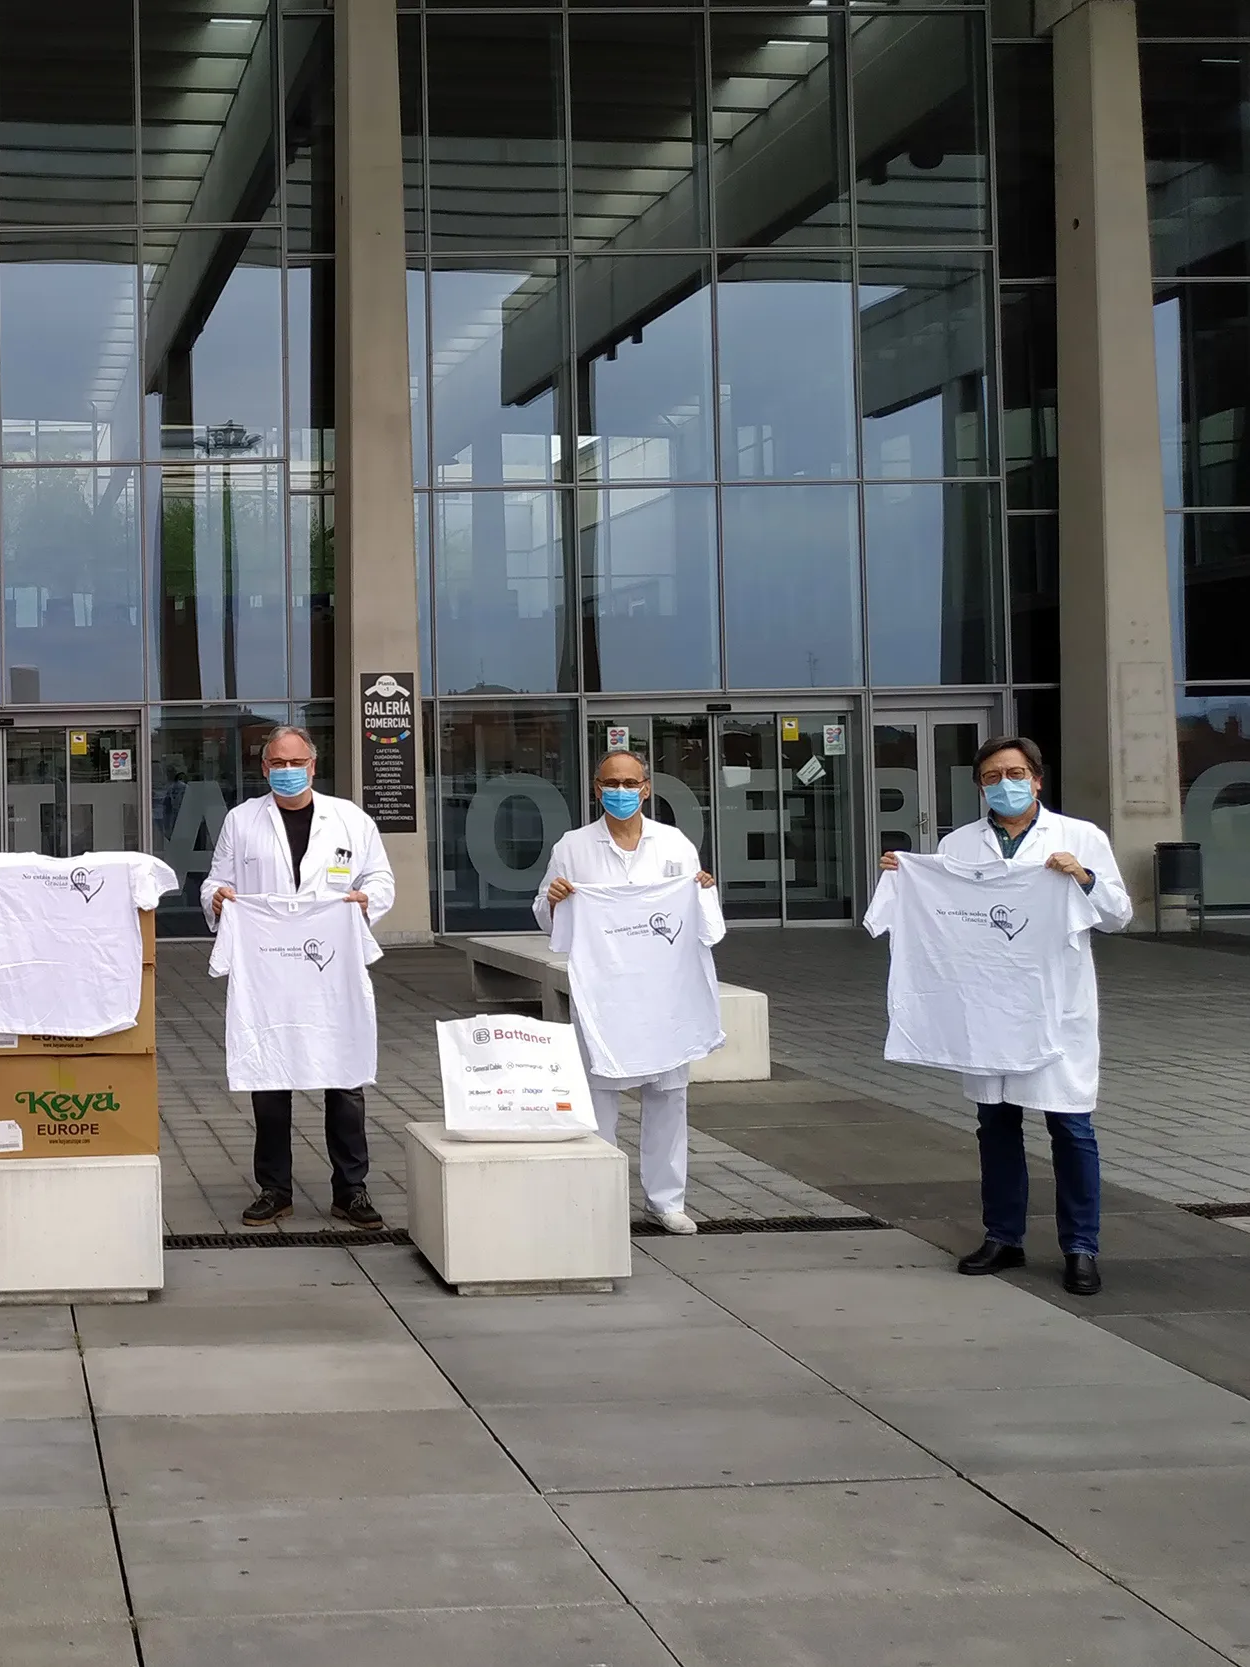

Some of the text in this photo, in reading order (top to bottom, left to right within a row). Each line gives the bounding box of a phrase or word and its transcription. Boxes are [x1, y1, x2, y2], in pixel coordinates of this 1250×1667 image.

[364, 698, 411, 716] GALERÍA
[364, 717, 411, 728] COMERCIAL
[494, 1029, 551, 1044] Battaner
[37, 1124, 99, 1136] EUROPE
